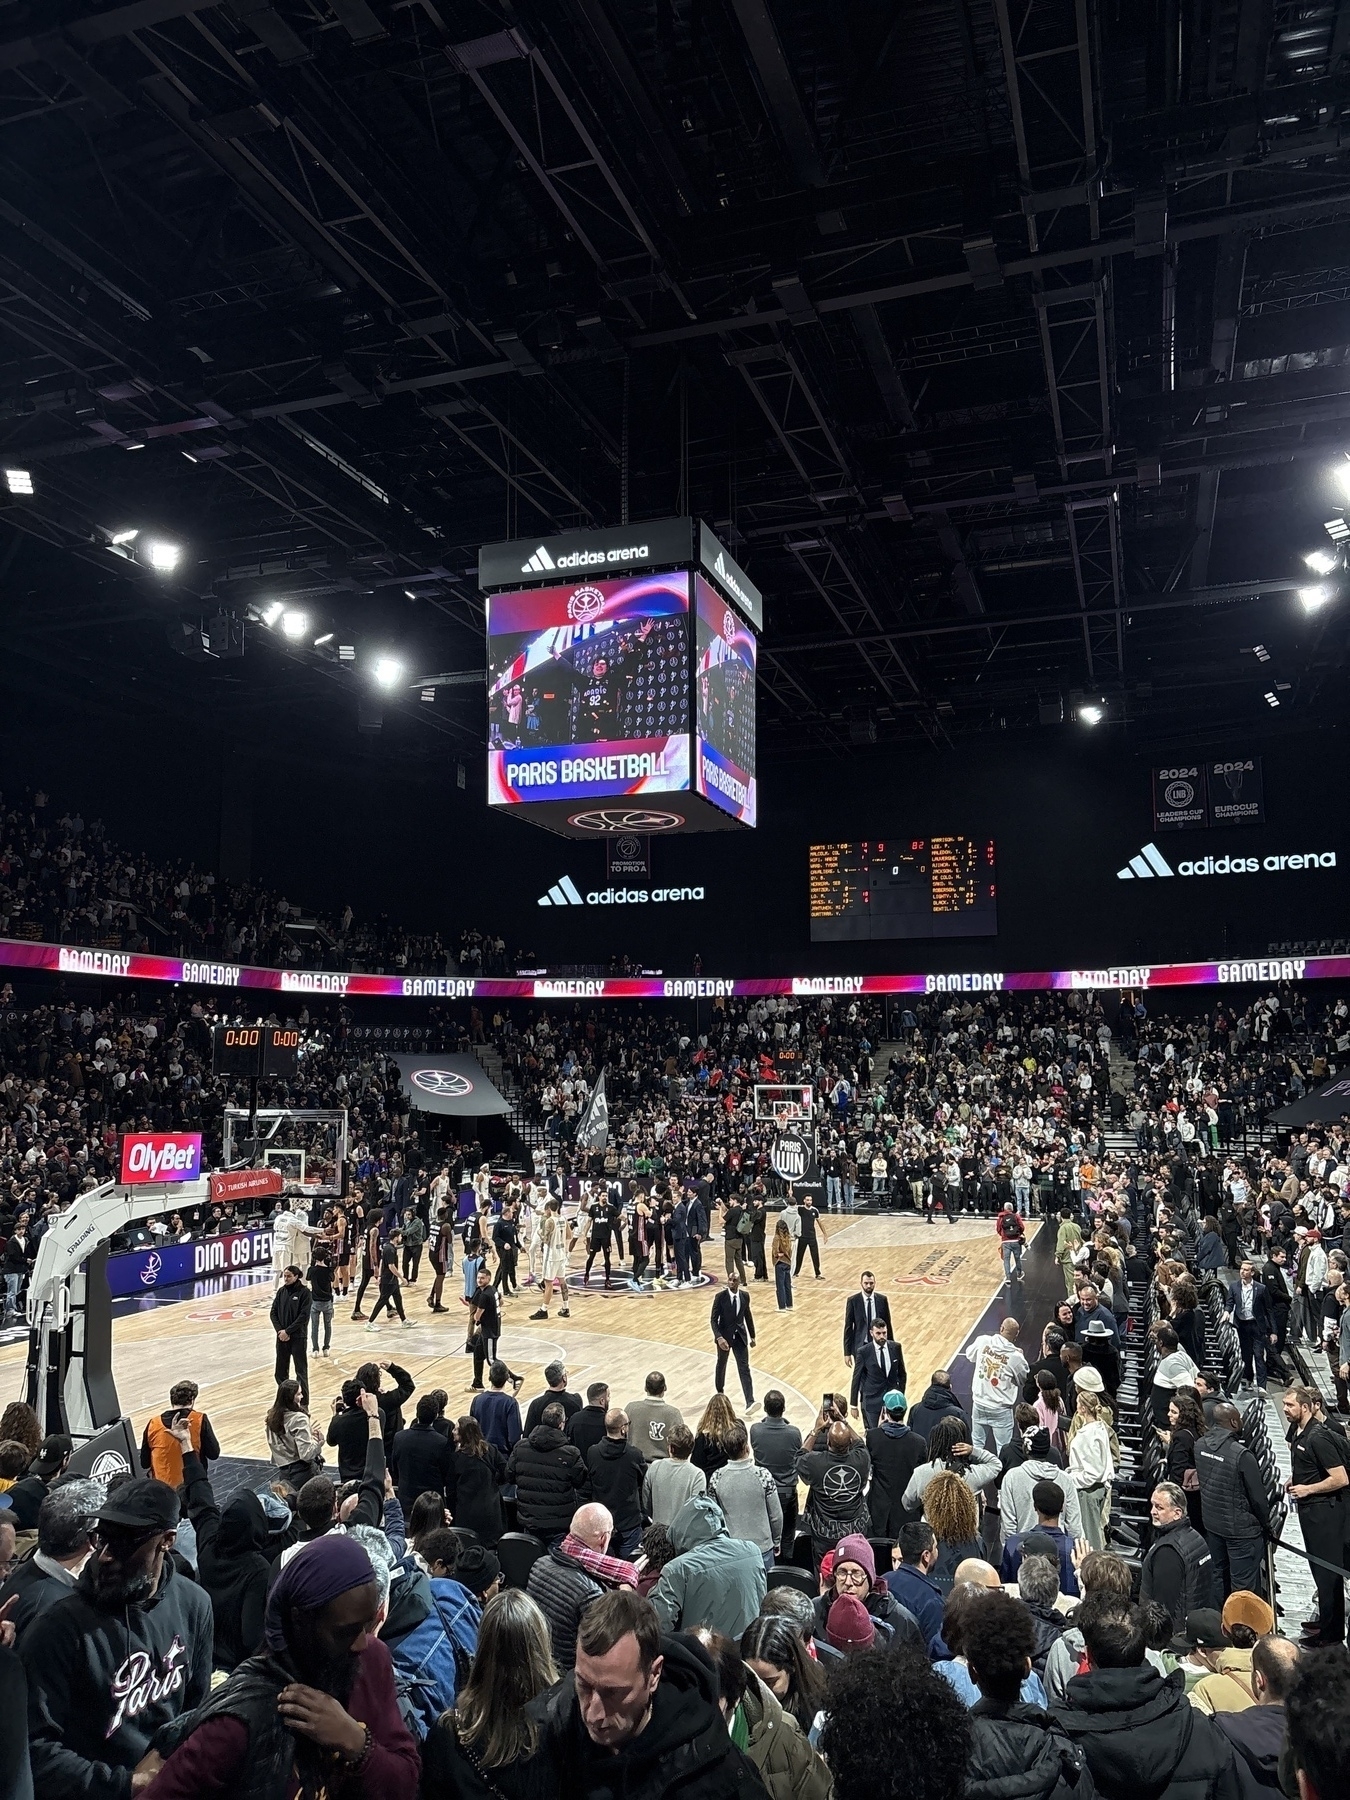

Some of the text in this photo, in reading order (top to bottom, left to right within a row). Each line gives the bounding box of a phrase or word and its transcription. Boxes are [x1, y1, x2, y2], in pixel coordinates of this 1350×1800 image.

[557, 545, 648, 568] adidas arena
[589, 694, 601, 706] 92
[507, 752, 670, 787] PARIS BASKETBALL
[702, 756, 718, 788] PARIS
[1159, 768, 1198, 780] 2024
[1214, 760, 1254, 774] 2024
[1173, 789, 1186, 799] LNB
[1214, 803, 1258, 812] EUROCUP
[1215, 809, 1259, 818] CHAMPIONS
[912, 841, 924, 850] 82
[1178, 850, 1338, 876] adidas arena
[587, 885, 705, 905] adidas arena
[182, 962, 240, 986] GAMEDAY
[1218, 960, 1306, 982] GAMEDAY
[402, 978, 475, 997] GAMEDAY
[664, 980, 734, 997] GAMEDAY
[926, 974, 1004, 992] GAMEDAY
[225, 1030, 259, 1046] 0:00
[272, 1031, 298, 1047] 0:00
[780, 1140, 802, 1153] PARIS
[129, 1142, 196, 1179] OlyBet
[777, 1150, 804, 1174] WIN
[227, 1177, 269, 1192] TURKISH AIRLINES
[66, 1224, 96, 1257] SPALDING
[194, 1242, 228, 1274] DIM.
[231, 1238, 249, 1267] 09
[106, 1635, 189, 1738] Paris
